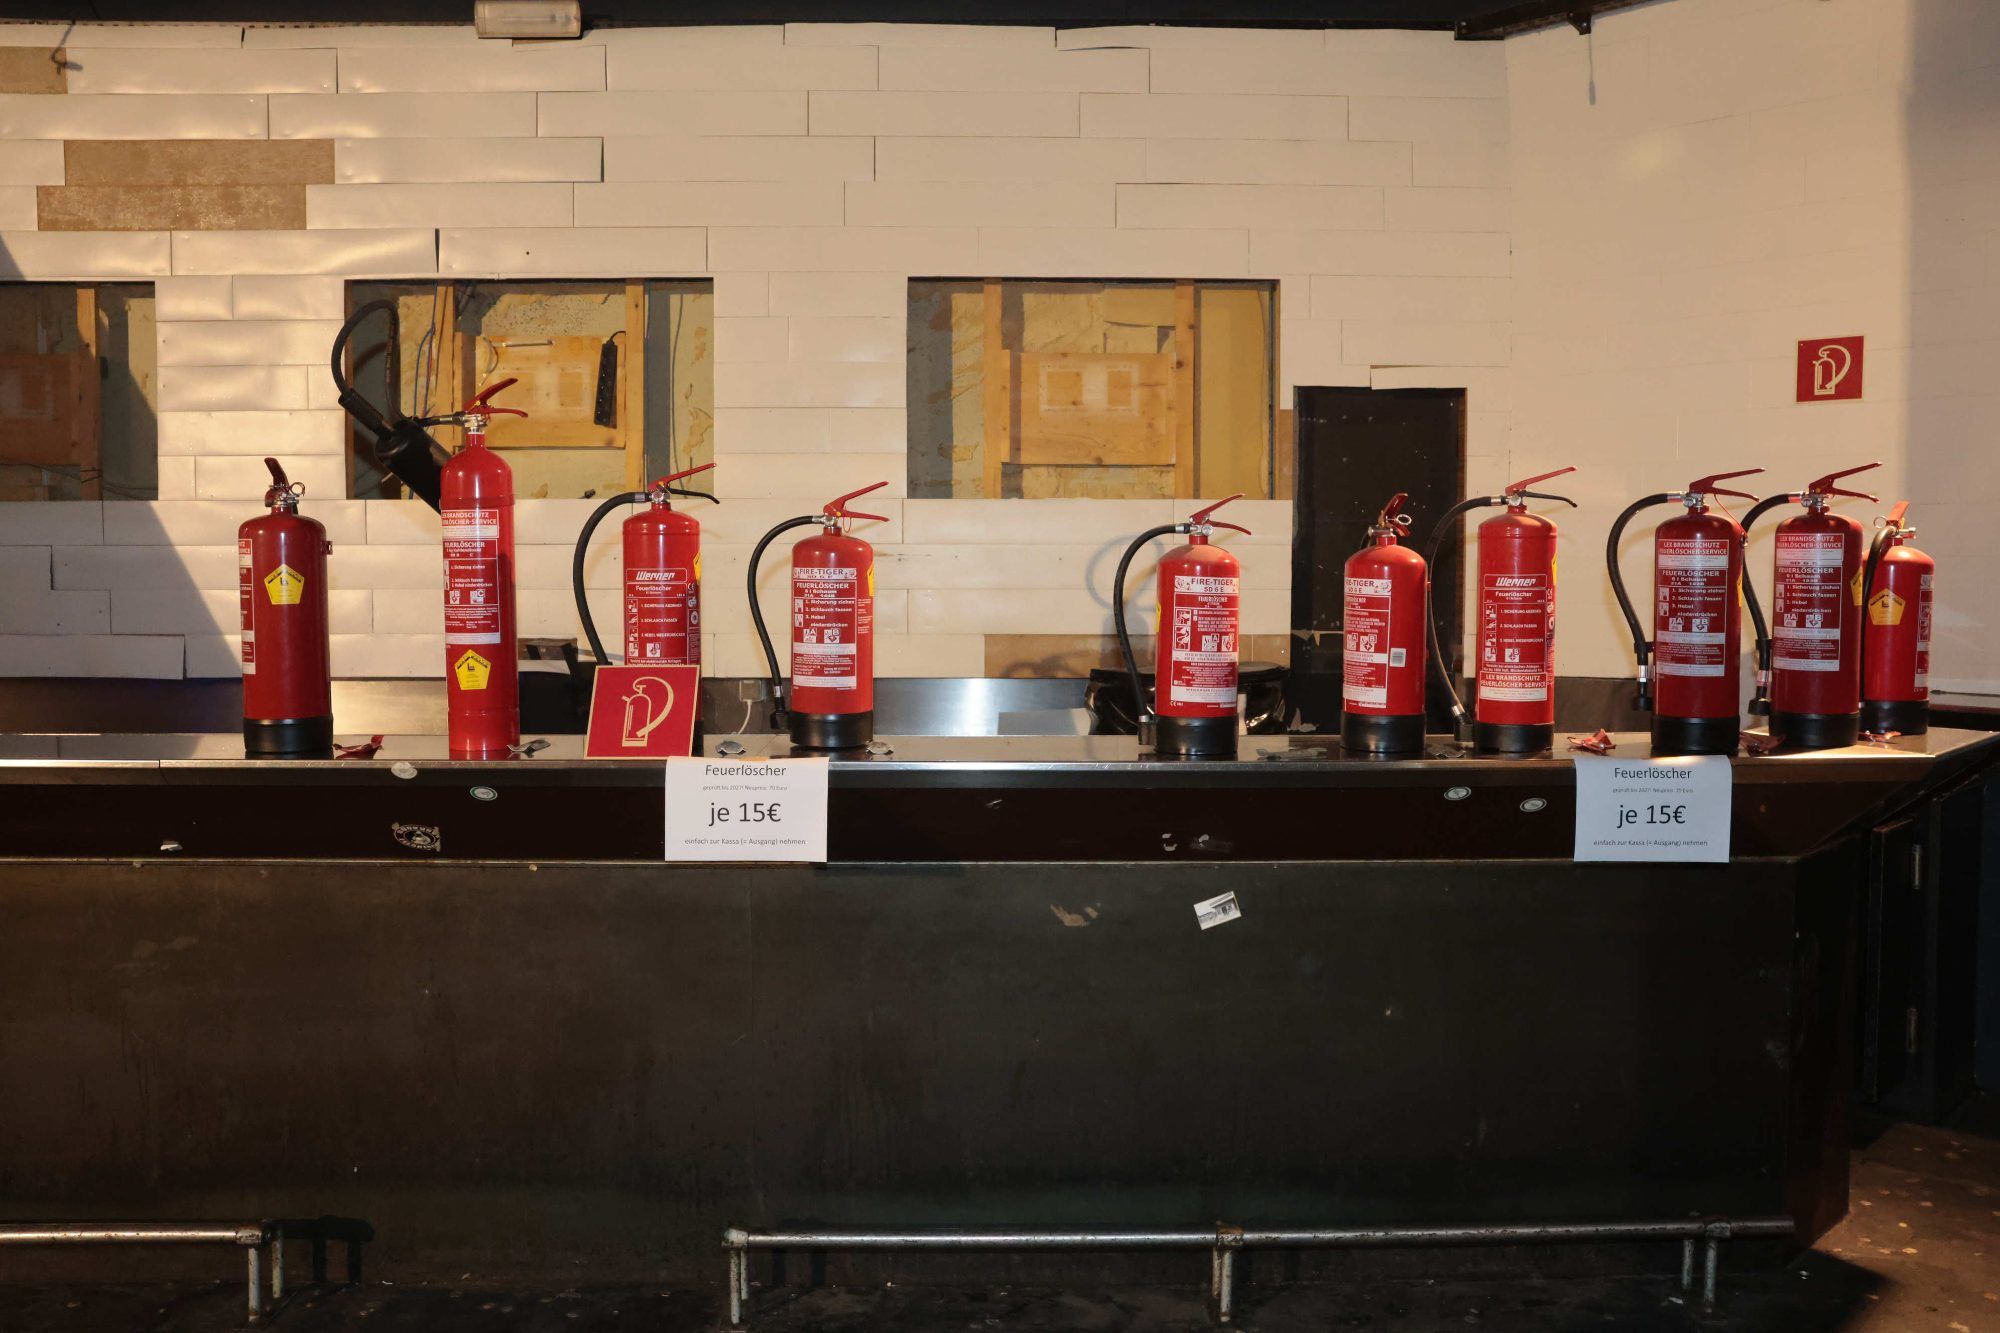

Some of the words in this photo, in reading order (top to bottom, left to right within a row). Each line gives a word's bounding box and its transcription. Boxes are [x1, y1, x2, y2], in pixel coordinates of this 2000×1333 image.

[636, 571, 675, 580] Werner
[1496, 577, 1536, 586] Werner
[705, 764, 786, 776] Feuerlöscher
[1614, 767, 1692, 779] Feuerlöscher
[708, 802, 730, 827] je
[739, 803, 781, 822] 15€
[1617, 805, 1638, 828] je
[1646, 805, 1686, 824] 15€
